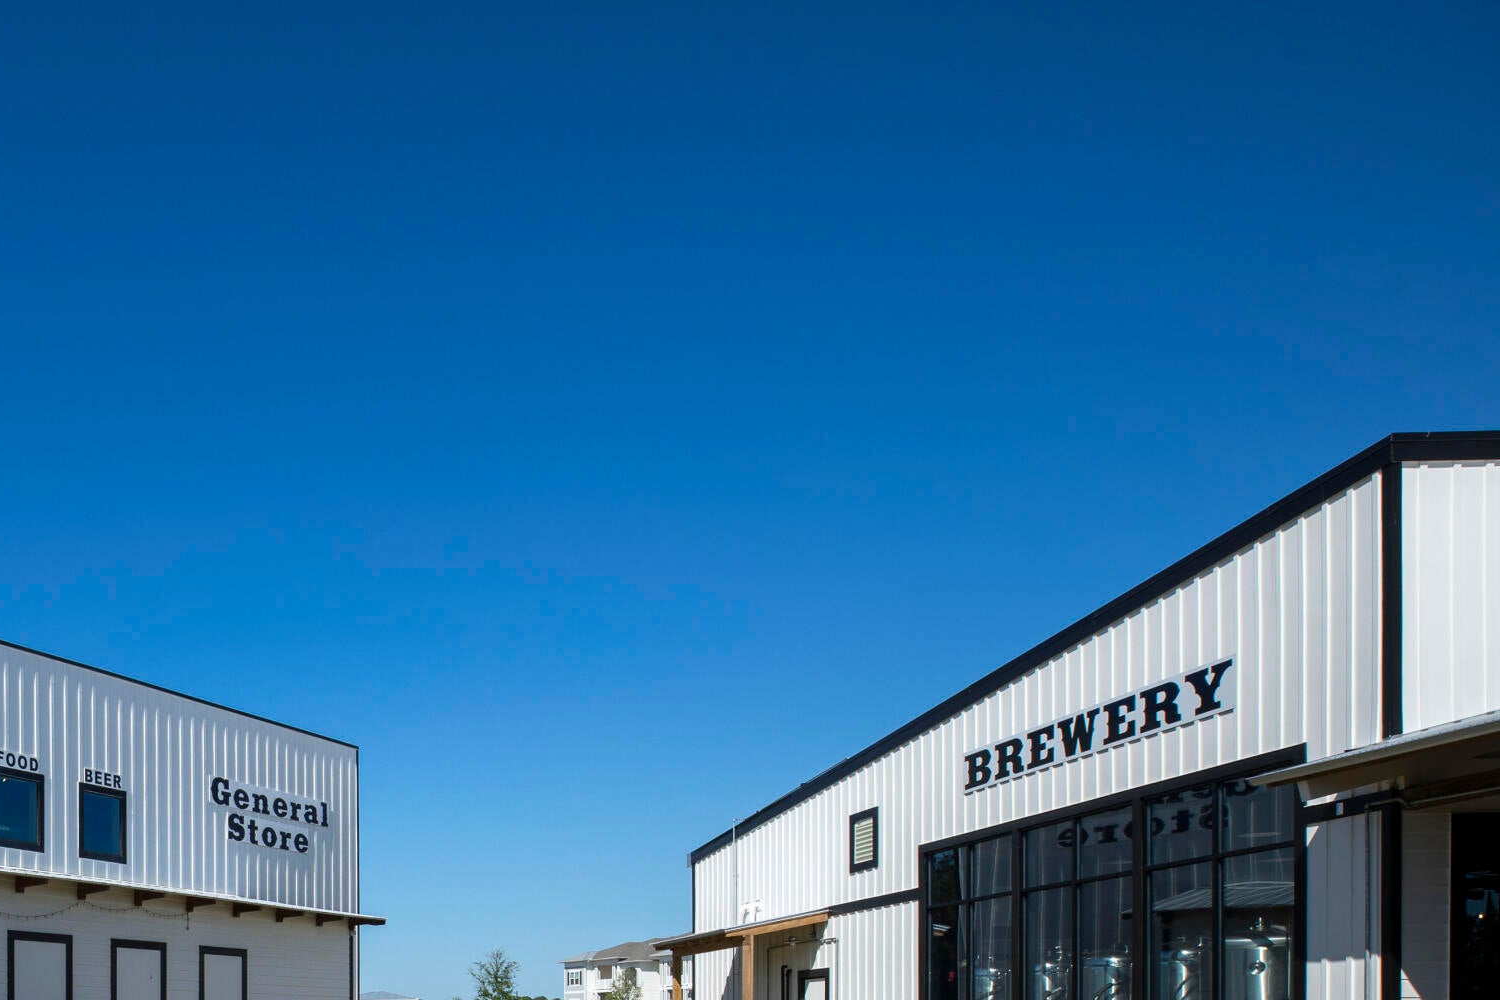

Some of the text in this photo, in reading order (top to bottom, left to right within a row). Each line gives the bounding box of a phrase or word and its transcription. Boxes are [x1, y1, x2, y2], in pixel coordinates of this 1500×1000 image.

[964, 658, 1233, 790] BREWERY
[84, 768, 122, 789] BEER
[210, 776, 329, 827] General
[227, 813, 309, 854] Store
